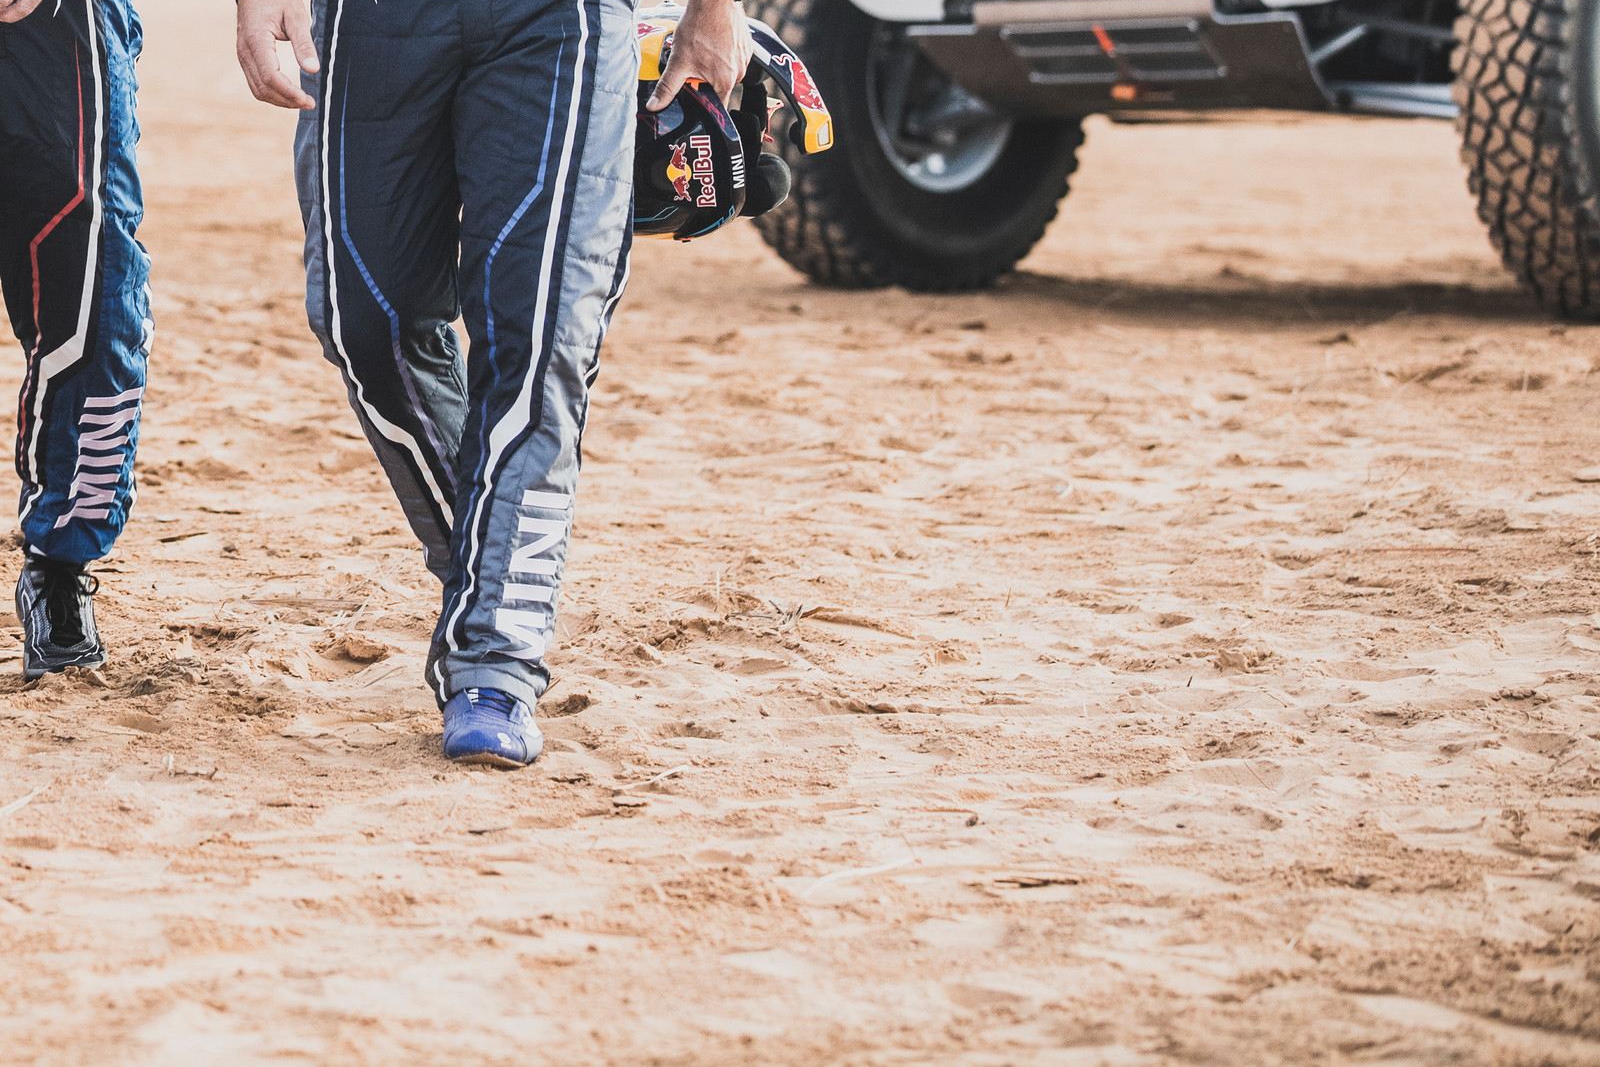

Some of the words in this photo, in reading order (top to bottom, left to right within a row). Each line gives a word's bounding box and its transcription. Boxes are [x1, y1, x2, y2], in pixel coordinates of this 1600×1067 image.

[690, 135, 714, 174] Bull
[731, 154, 745, 189] MINI
[693, 171, 717, 208] Red
[54, 387, 143, 529] MINI
[483, 489, 571, 668] MINI
